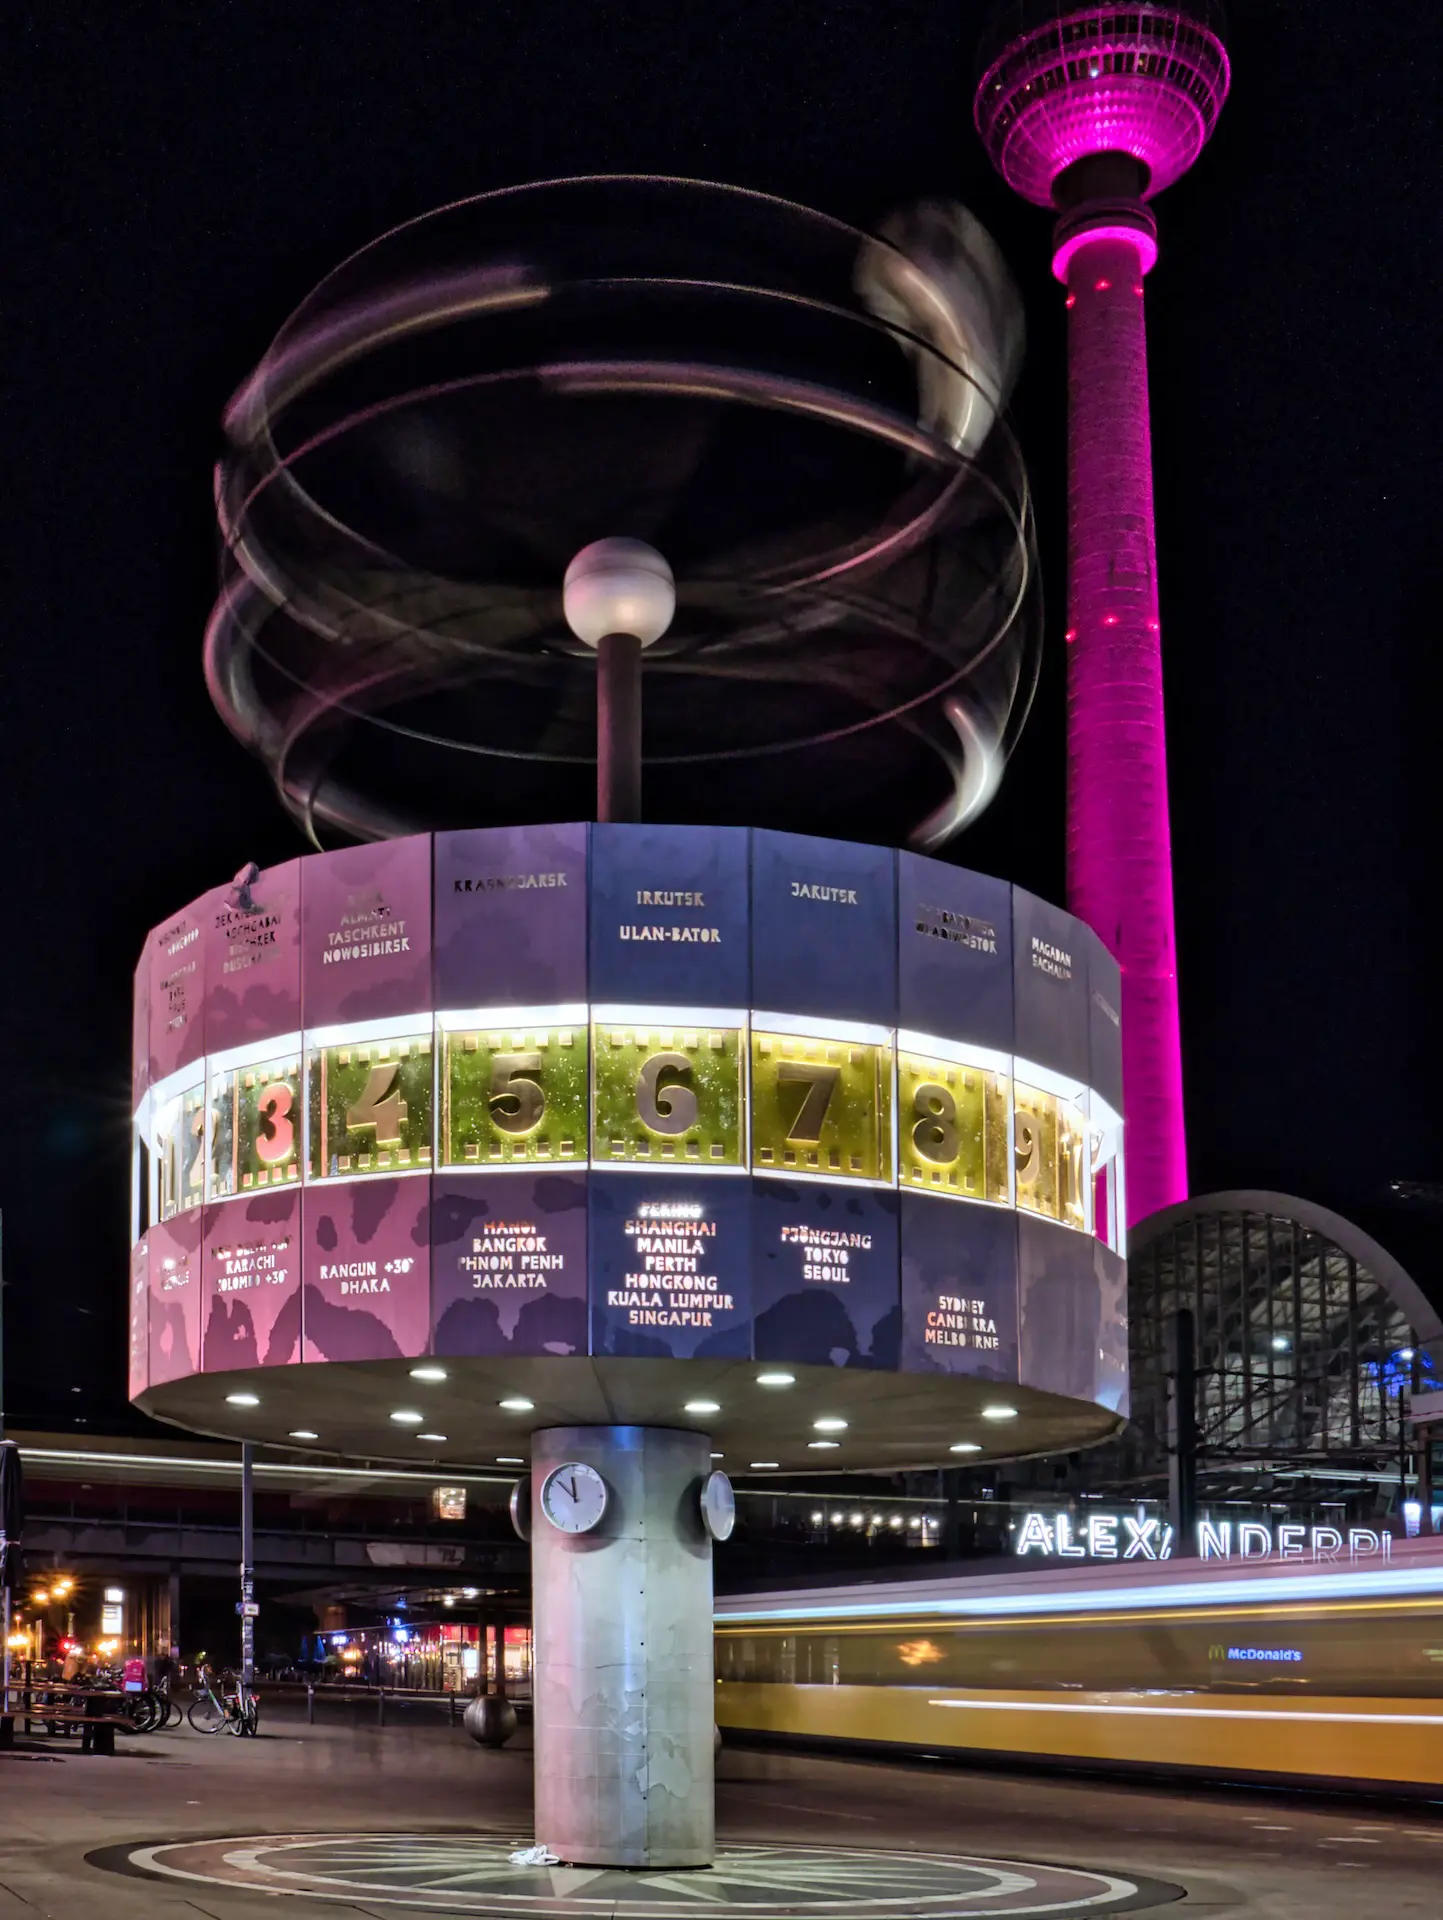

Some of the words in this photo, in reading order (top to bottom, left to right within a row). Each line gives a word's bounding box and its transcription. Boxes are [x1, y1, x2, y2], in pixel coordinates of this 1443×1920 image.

[636, 890, 705, 906] IRKUTSK
[791, 882, 858, 905] JAKUTSK
[328, 920, 406, 946] TASCHKENT
[620, 925, 721, 943] ULAN-BATOR
[323, 937, 410, 964] NOWOSIBIRSK
[1032, 936, 1072, 967] MAGADAN
[346, 1062, 408, 1144] 4
[488, 1052, 546, 1135] 5
[636, 1052, 698, 1136] 6
[776, 1061, 841, 1142] 7
[255, 1082, 294, 1163] 3
[912, 1083, 960, 1164] 8
[624, 1220, 717, 1237] SHANGHAI
[472, 1236, 548, 1253] BANGKOK
[637, 1238, 705, 1255] MANILA
[225, 1254, 276, 1275] KARACHI
[520, 1255, 564, 1270] PENH
[645, 1256, 697, 1273] PERTH
[804, 1247, 849, 1265] TOKYO
[319, 1261, 377, 1280] RANGUN
[803, 1264, 850, 1283] SEOUL
[340, 1277, 391, 1295] DHAKA
[472, 1273, 547, 1289] JAKARTA
[625, 1273, 718, 1290] HONGKONG
[607, 1291, 663, 1308] KUALA
[669, 1293, 734, 1310] LUMPUR
[629, 1310, 713, 1327] SINGAPUR
[1226, 1647, 1303, 1663] McDonald's
